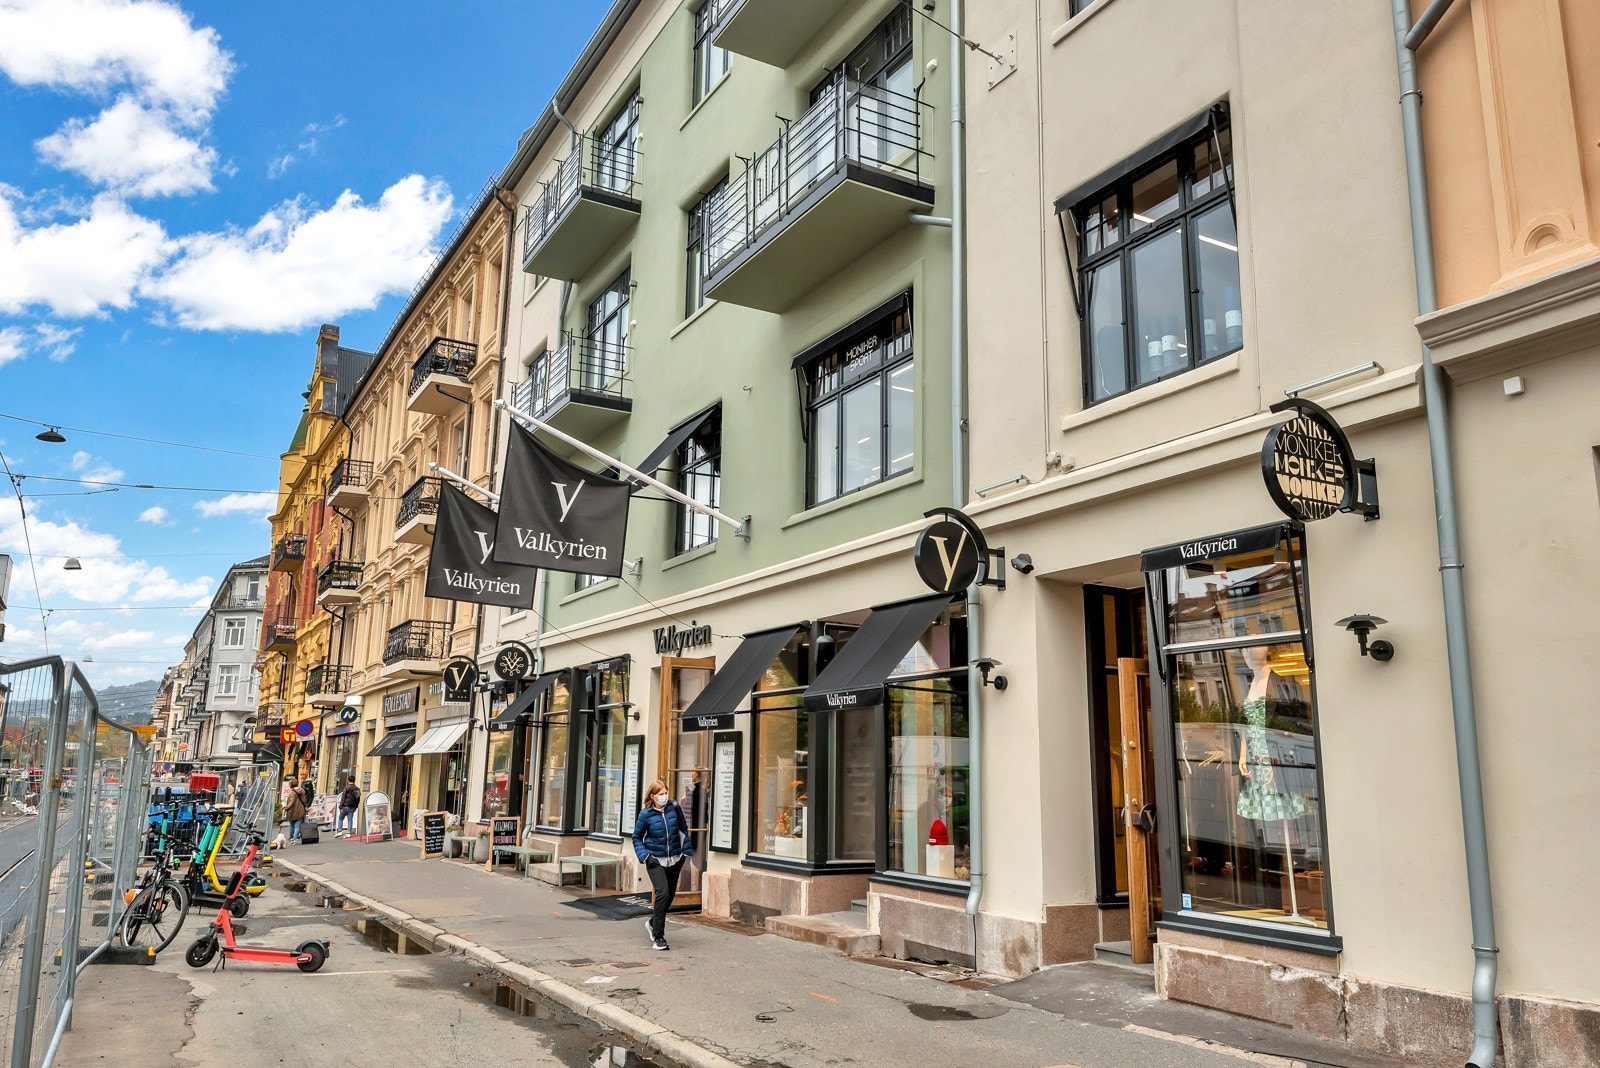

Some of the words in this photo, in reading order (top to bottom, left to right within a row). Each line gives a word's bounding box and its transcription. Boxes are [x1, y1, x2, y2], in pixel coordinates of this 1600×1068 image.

[1274, 452, 1345, 484] MONIKER
[513, 526, 608, 562] Valkyrien
[1179, 537, 1238, 559] Valkyrien
[443, 567, 521, 596] Valkyrien
[652, 620, 712, 657] Valkyrien
[384, 692, 412, 713] FOLLESTAD
[826, 692, 858, 709] Valkyrien
